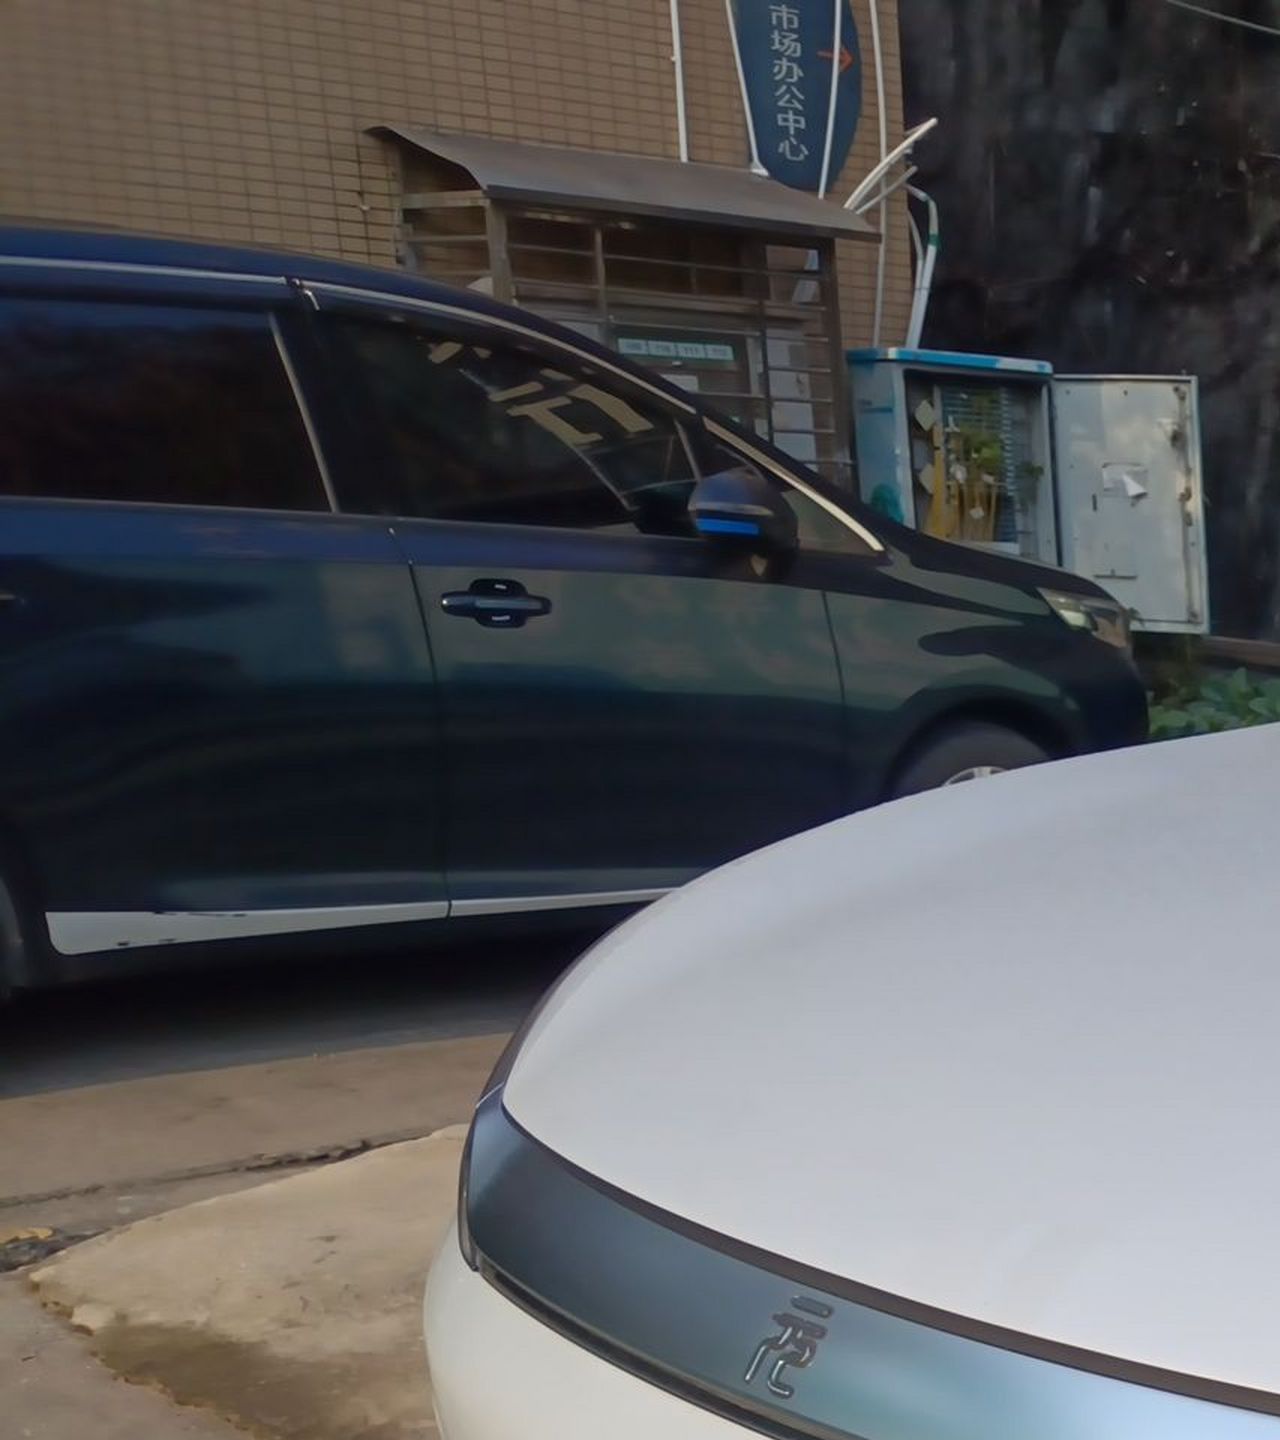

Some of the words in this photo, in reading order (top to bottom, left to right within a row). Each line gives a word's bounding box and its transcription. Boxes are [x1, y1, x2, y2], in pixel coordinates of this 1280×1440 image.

[769, 4, 809, 161] 市场办公中心
